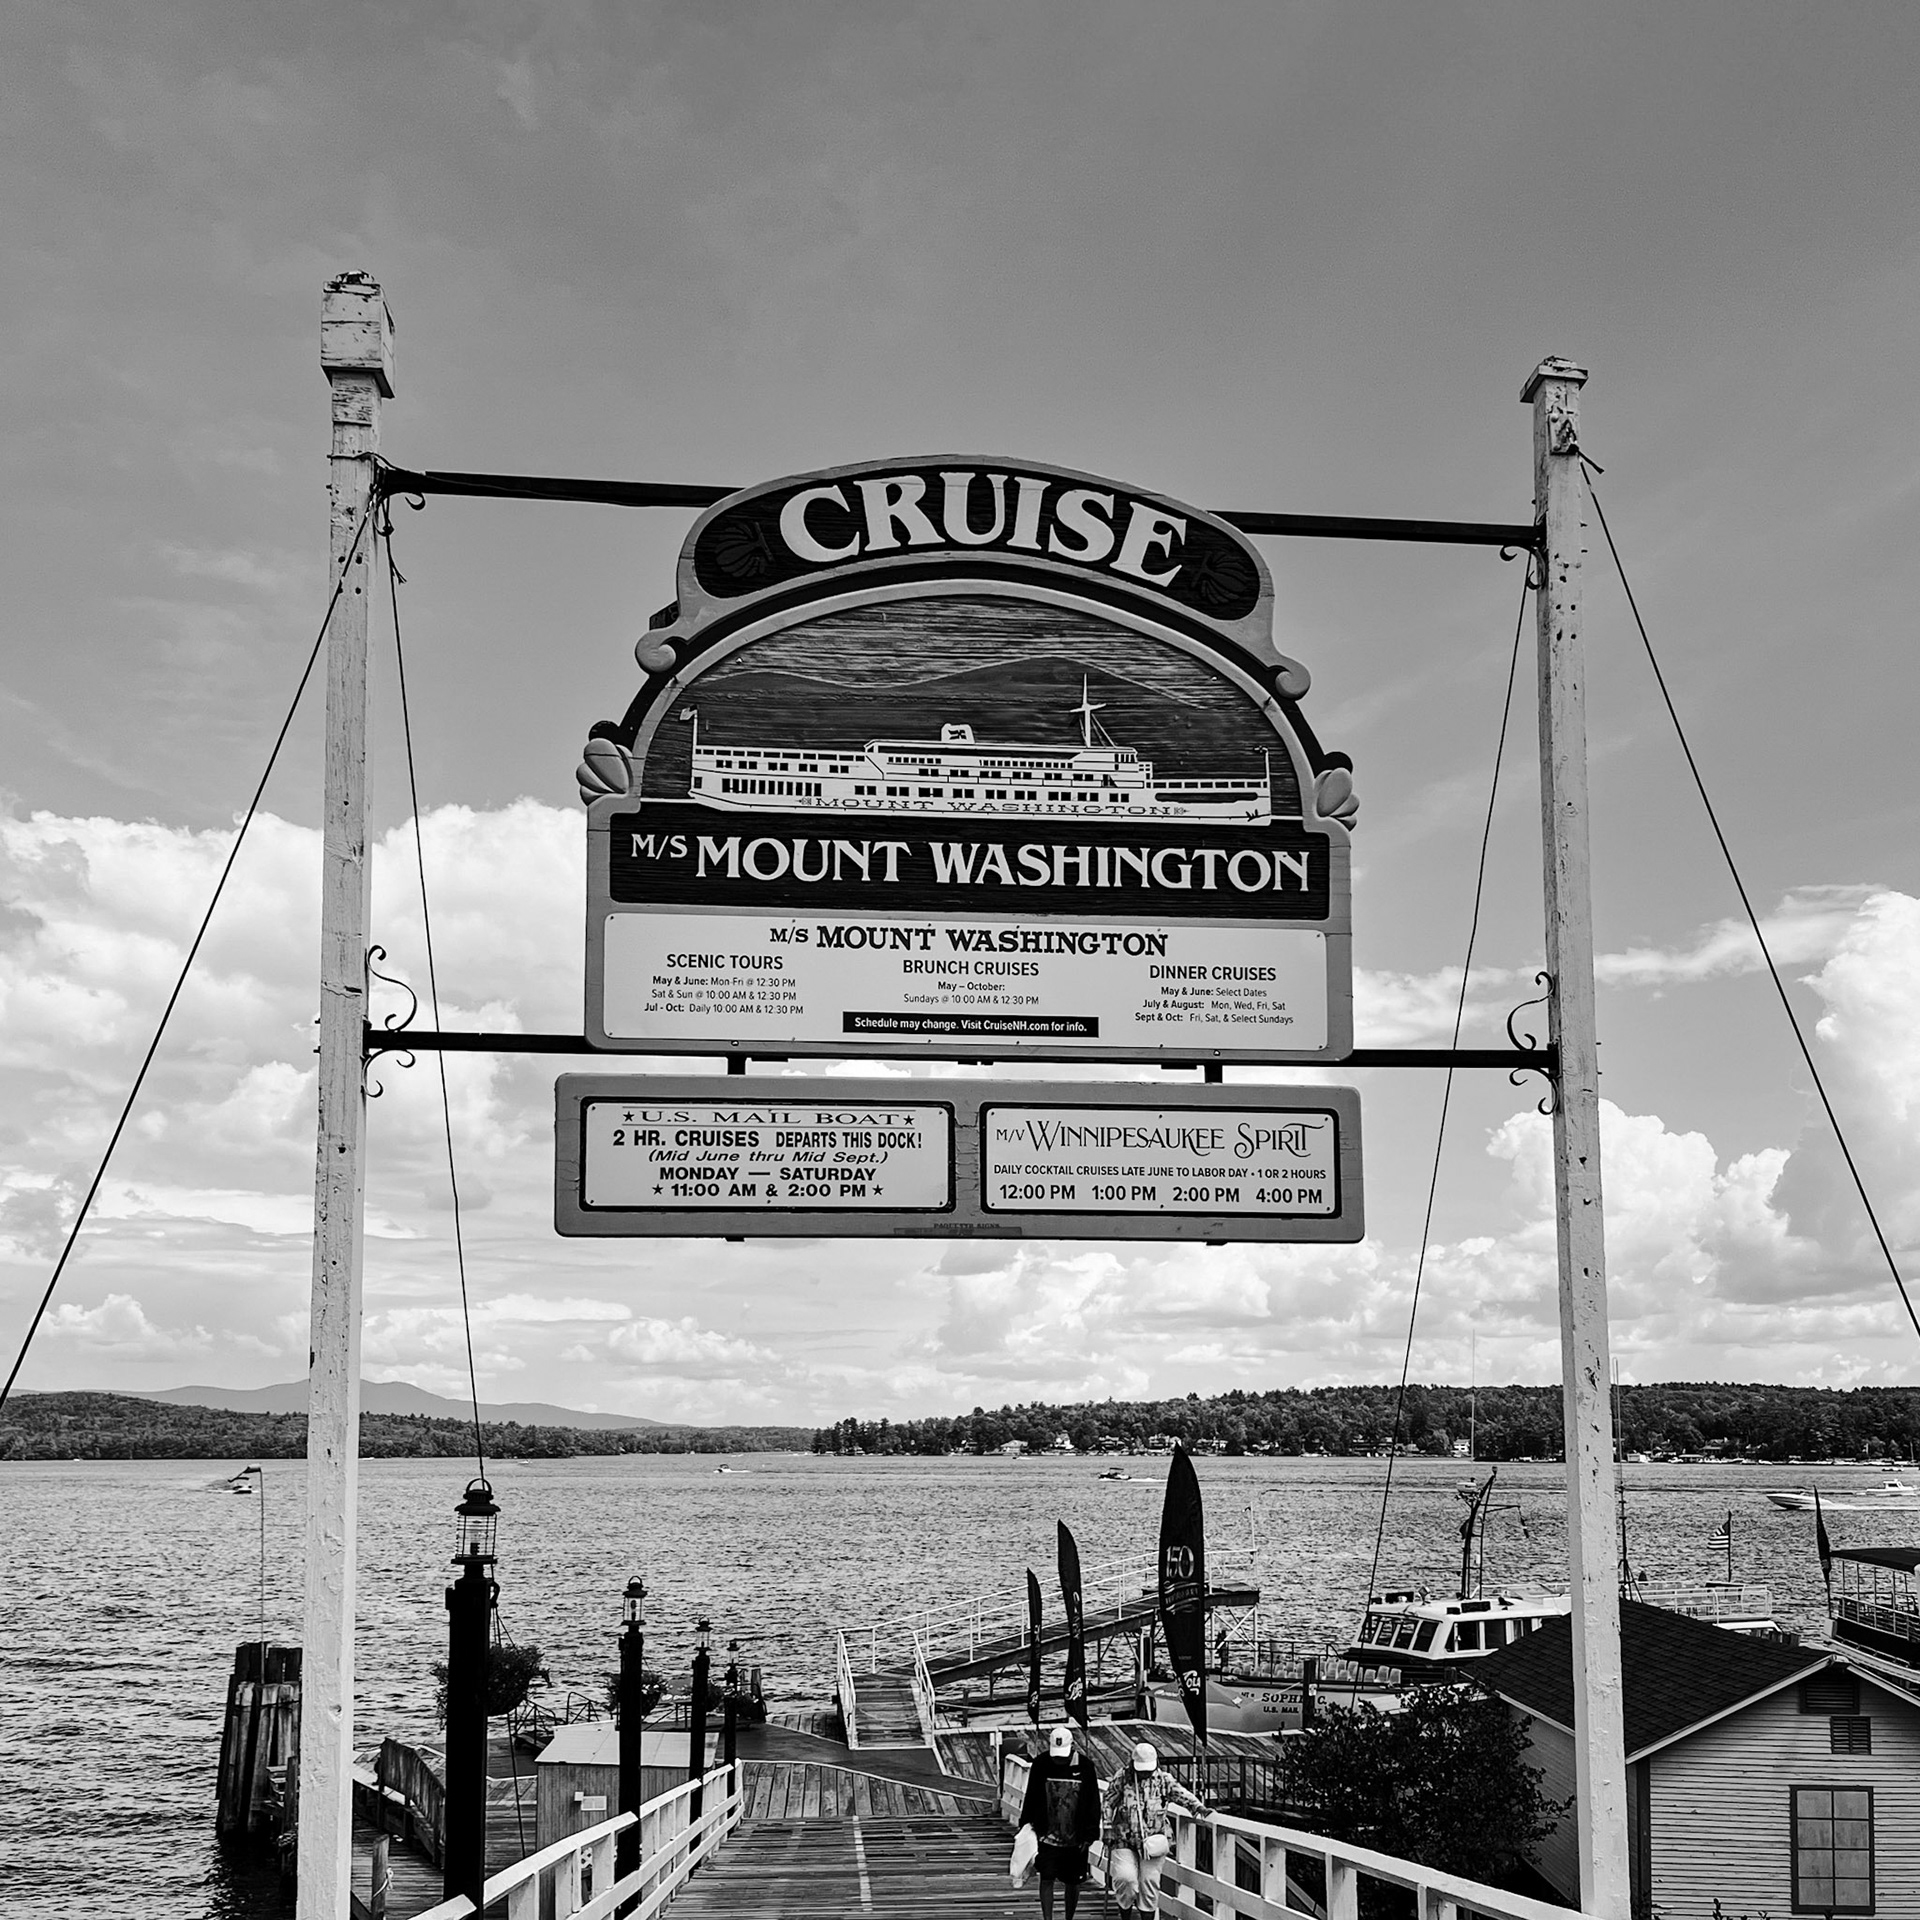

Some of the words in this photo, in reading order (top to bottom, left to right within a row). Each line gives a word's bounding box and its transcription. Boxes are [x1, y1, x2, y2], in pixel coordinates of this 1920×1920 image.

[779, 472, 1188, 587] CRUISE
[816, 797, 934, 810] MOUNT
[948, 801, 1173, 815] WASHINGTON
[632, 834, 687, 859] M/S
[696, 836, 911, 881] MOUNT
[929, 842, 1309, 892] WASHINGTON
[770, 927, 808, 944] M/S
[817, 926, 935, 950] MOUNT
[946, 929, 1168, 957] WASHINGTON
[667, 954, 725, 968] SCENIC
[730, 955, 783, 969] TOURS
[904, 960, 968, 974] BRUNCH
[974, 961, 1039, 976] CRUISES
[1150, 965, 1207, 979] DINNER
[1212, 966, 1276, 981] CRUISES
[653, 976, 672, 986] May
[675, 976, 680, 985] &
[683, 976, 708, 985] June:
[782, 978, 795, 987] PM
[938, 981, 957, 992] May
[967, 982, 1005, 991] October:
[652, 989, 665, 998] Sat
[668, 990, 674, 998] &
[677, 990, 692, 998] Sun
[732, 991, 746, 999] AM
[749, 991, 754, 1000] &
[783, 992, 796, 1000] PM
[904, 994, 939, 1004] Sundays
[977, 995, 990, 1003] AM
[993, 995, 998, 1004] &
[1026, 996, 1038, 1004] PM
[1161, 987, 1179, 997] May
[1182, 987, 1187, 995] &
[1190, 987, 1213, 995] June:
[1216, 987, 1241, 996] Select
[1244, 988, 1267, 997] Dates
[644, 1003, 658, 1011] Jul
[666, 1003, 684, 1012] Oct:
[689, 1004, 711, 1014] Daily
[739, 1005, 753, 1013] AM
[756, 1005, 761, 1013] &
[790, 1006, 803, 1014] PM
[1143, 1000, 1160, 1010] July
[1163, 1000, 1169, 1008] &
[1171, 1000, 1204, 1010] August:
[1211, 1001, 1231, 1010] Mon,
[1234, 1001, 1254, 1010] Wed,
[1272, 1002, 1285, 1010] Sat
[855, 1017, 898, 1027] Schedule
[900, 1021, 920, 1030] may
[922, 1019, 959, 1031] change.
[961, 1020, 981, 1029] Visit
[984, 1020, 1049, 1030] CruiseNH.com
[1051, 1022, 1064, 1031] for
[1067, 1022, 1086, 1031] info.
[1135, 1012, 1155, 1023] Sept
[1157, 1013, 1163, 1021] &
[1165, 1013, 1183, 1021] Oct:
[1205, 1013, 1221, 1023] Sat,
[1223, 1014, 1229, 1022] &
[1231, 1014, 1257, 1023] Select
[1259, 1014, 1293, 1025] Sundays
[640, 1111, 697, 1123] U.S.
[711, 1110, 801, 1124] MAIL
[816, 1113, 899, 1126] BOAT
[613, 1130, 625, 1146] 2
[634, 1130, 665, 1146] HR.
[675, 1130, 759, 1147] CRUISES
[776, 1132, 836, 1148] DEPARTS
[842, 1132, 871, 1148] THIS
[878, 1132, 921, 1148] DOCK!
[997, 1129, 1025, 1142] M/V
[649, 1149, 689, 1162] (Mid
[696, 1151, 739, 1161] June
[750, 1151, 784, 1161] thru
[792, 1152, 826, 1162] Mid
[833, 1151, 888, 1164] Sept.)
[660, 1167, 739, 1180] MONDAY
[780, 1167, 876, 1181] SATURDAY
[994, 1165, 1022, 1174] DAILY
[1025, 1165, 1074, 1175] COCKTAIL
[1076, 1166, 1119, 1175] CRUISES
[1122, 1167, 1145, 1176] LATE
[1147, 1167, 1173, 1176] JUNE
[1176, 1167, 1189, 1177] TO
[1192, 1167, 1225, 1177] LABOR
[1228, 1168, 1248, 1177] DAY
[1257, 1169, 1262, 1178] 1
[1265, 1169, 1279, 1178] OR
[1282, 1169, 1288, 1178] 2
[1291, 1169, 1326, 1179] HOURS
[671, 1184, 719, 1196] 11:00
[728, 1184, 756, 1196] AM
[766, 1184, 778, 1197] &
[788, 1184, 831, 1197] 2:00
[840, 1184, 865, 1197] PM
[1000, 1185, 1045, 1199] 12:00
[1051, 1185, 1075, 1199] PM
[1092, 1185, 1126, 1200] 1:00
[1132, 1186, 1155, 1200] PM
[1173, 1187, 1209, 1202] 2:00
[1215, 1188, 1239, 1202] PM
[1256, 1188, 1292, 1203] 4:00
[1298, 1189, 1322, 1203] PM
[1166, 1545, 1194, 1578] 150
[1262, 1693, 1303, 1703] SOPHI
